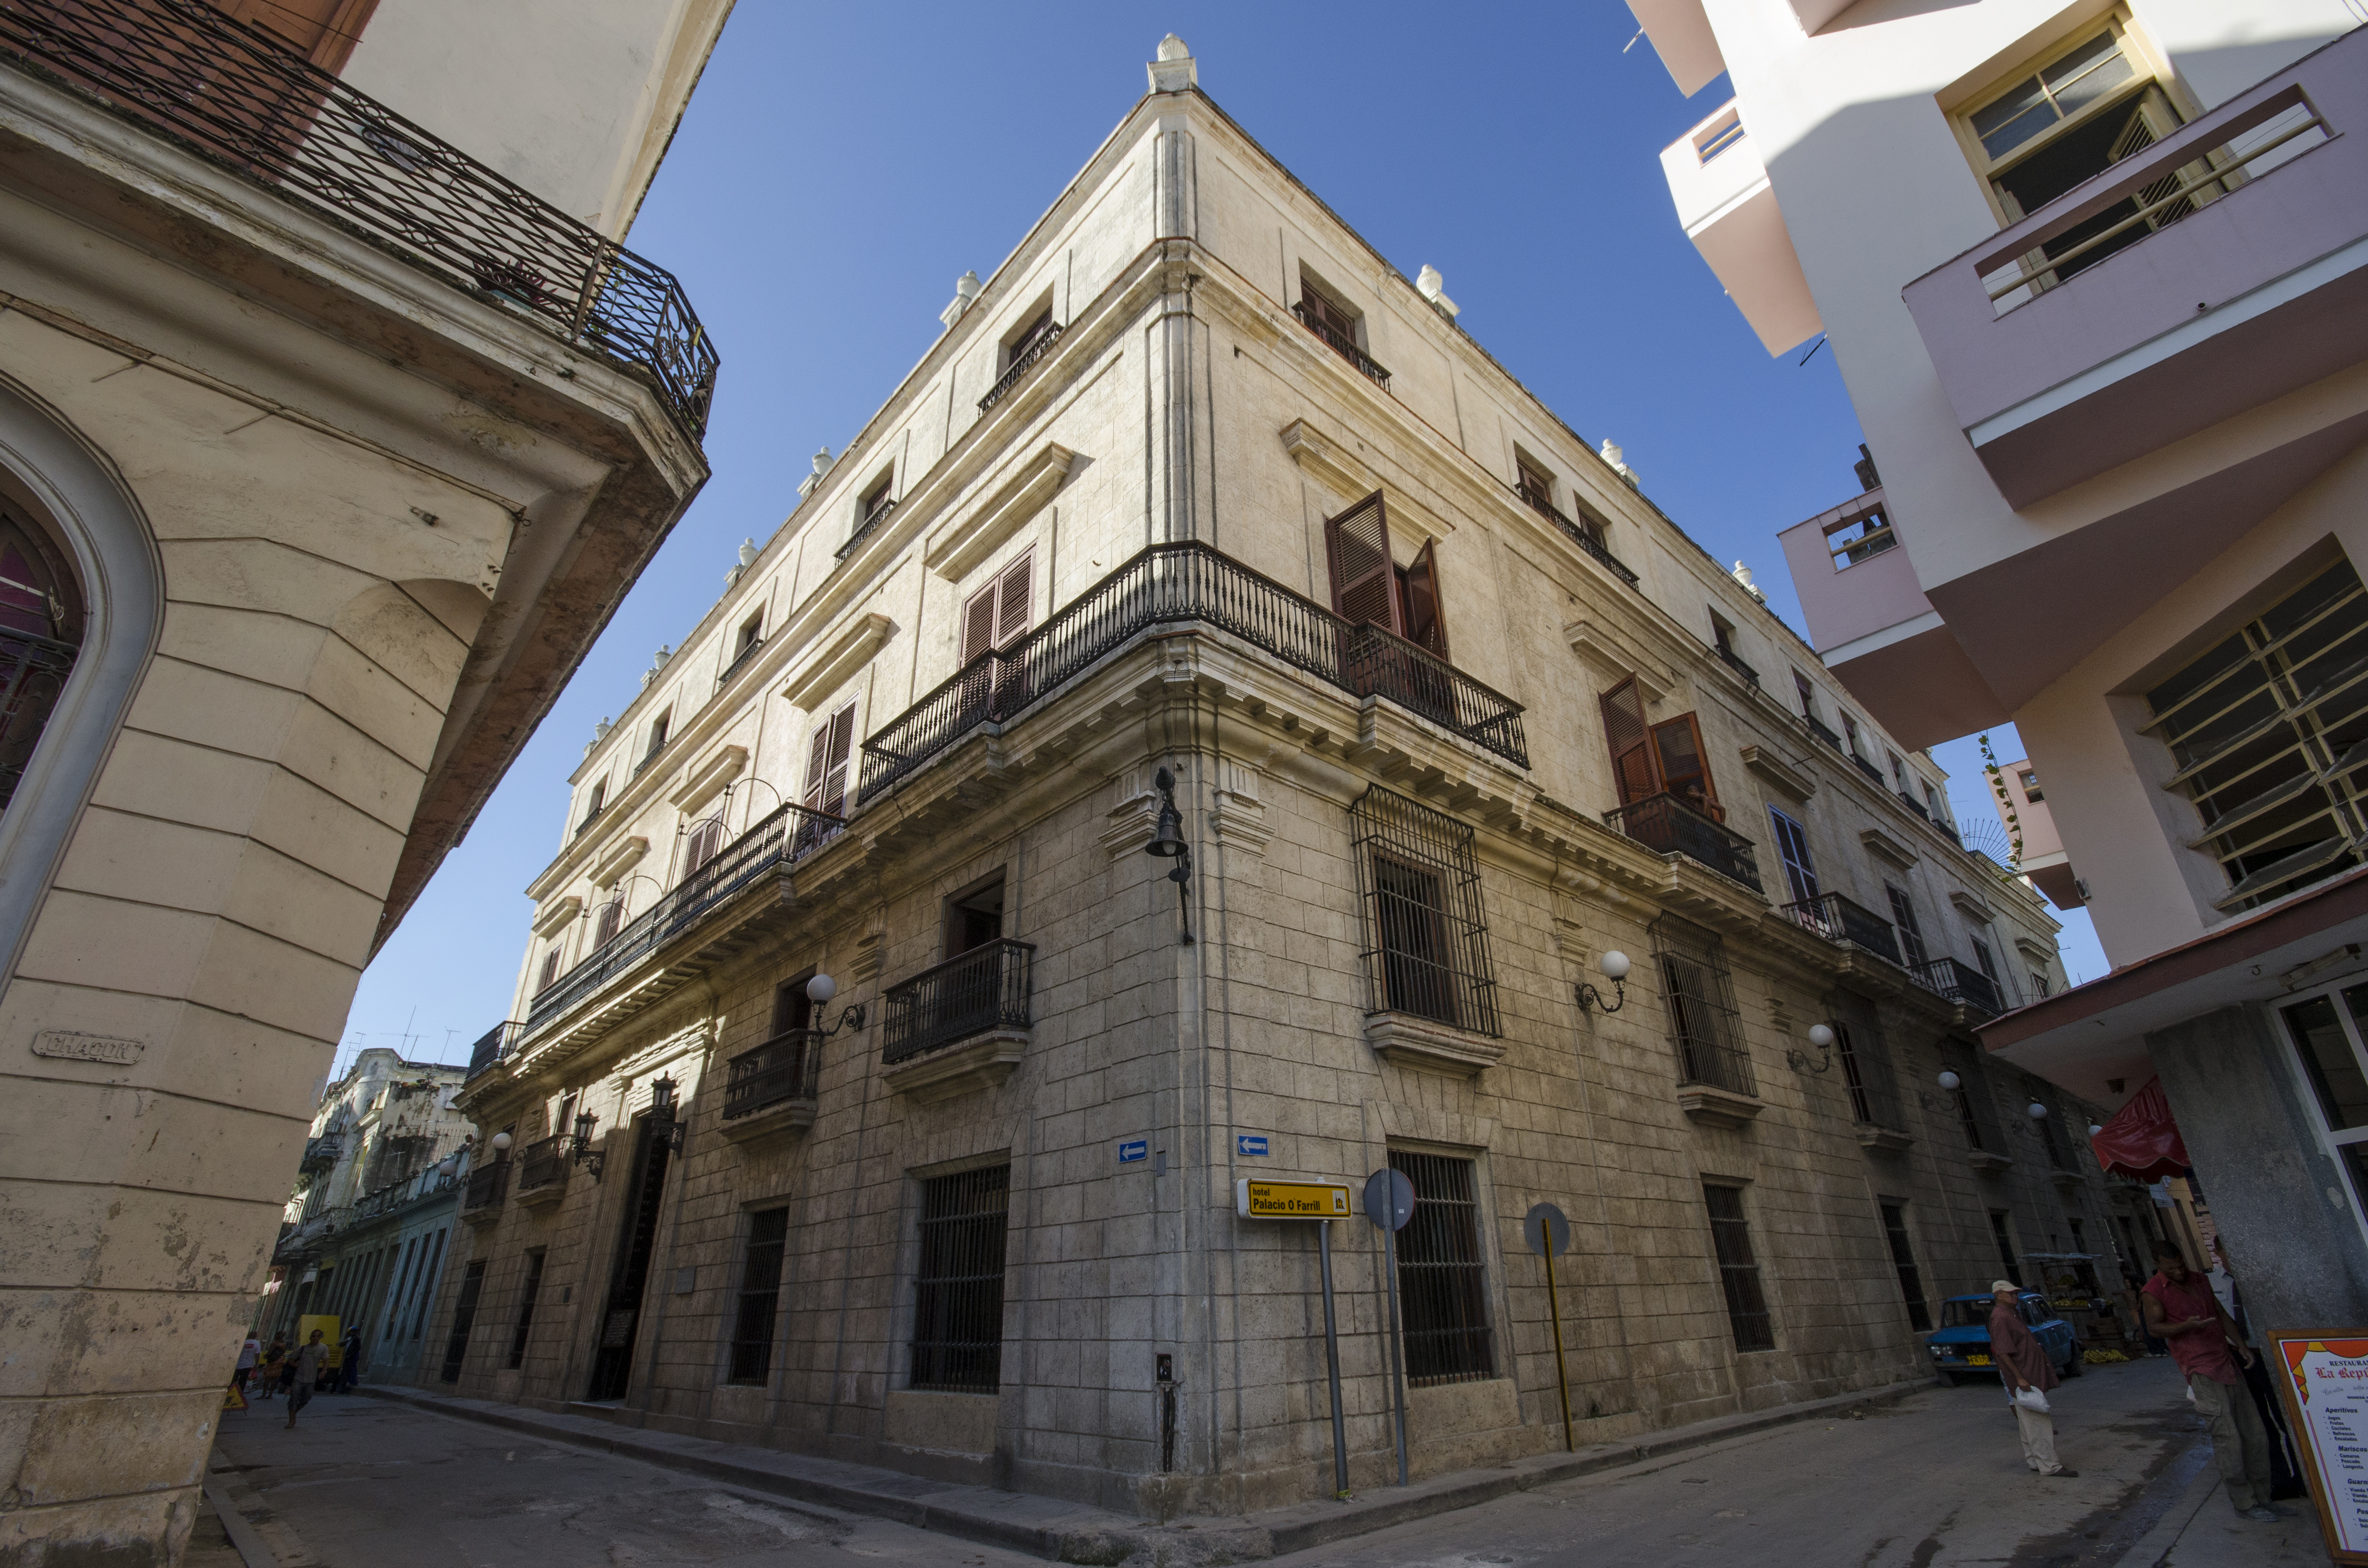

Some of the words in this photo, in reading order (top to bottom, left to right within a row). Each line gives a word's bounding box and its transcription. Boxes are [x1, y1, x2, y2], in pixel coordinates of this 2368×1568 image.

[46, 1036, 130, 1060] CHACON
[1253, 1188, 1270, 1196] hotel
[1253, 1198, 1286, 1210] Palacio
[2315, 1367, 2335, 1378] La
